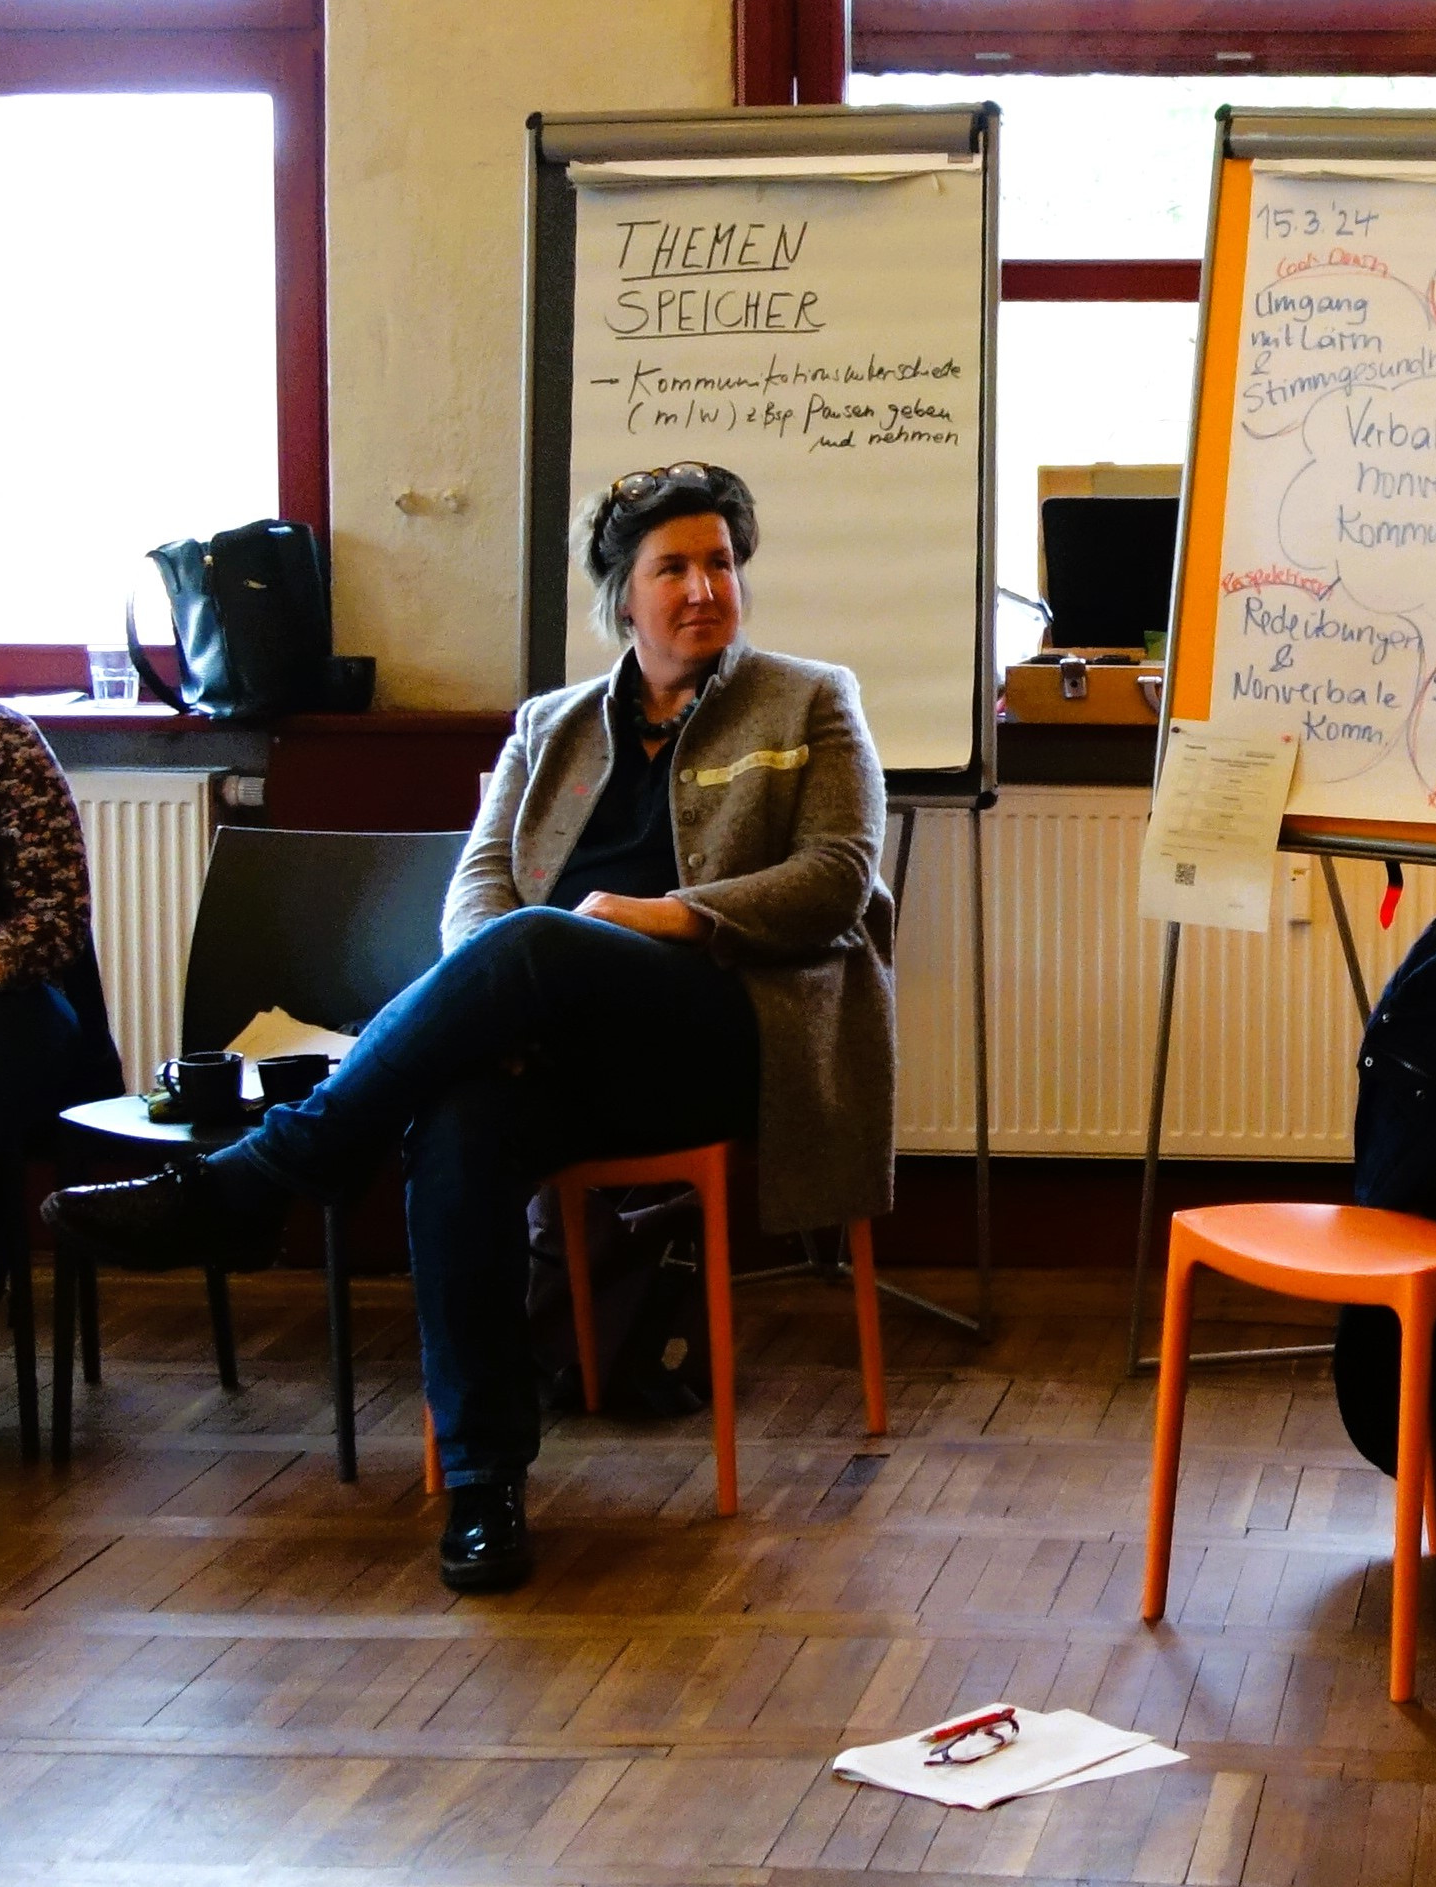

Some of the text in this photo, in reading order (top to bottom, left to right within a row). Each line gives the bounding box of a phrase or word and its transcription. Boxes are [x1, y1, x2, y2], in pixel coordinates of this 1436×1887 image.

[616, 221, 809, 277] THEMEN
[605, 290, 826, 339] SPEICHER
[1255, 291, 1369, 325] Umgang
[1251, 323, 1383, 352] mit Lärm
[803, 393, 875, 434] Pausen
[879, 398, 954, 431] geben
[868, 425, 960, 446] nehmen
[1234, 664, 1399, 708] Nonverbale
